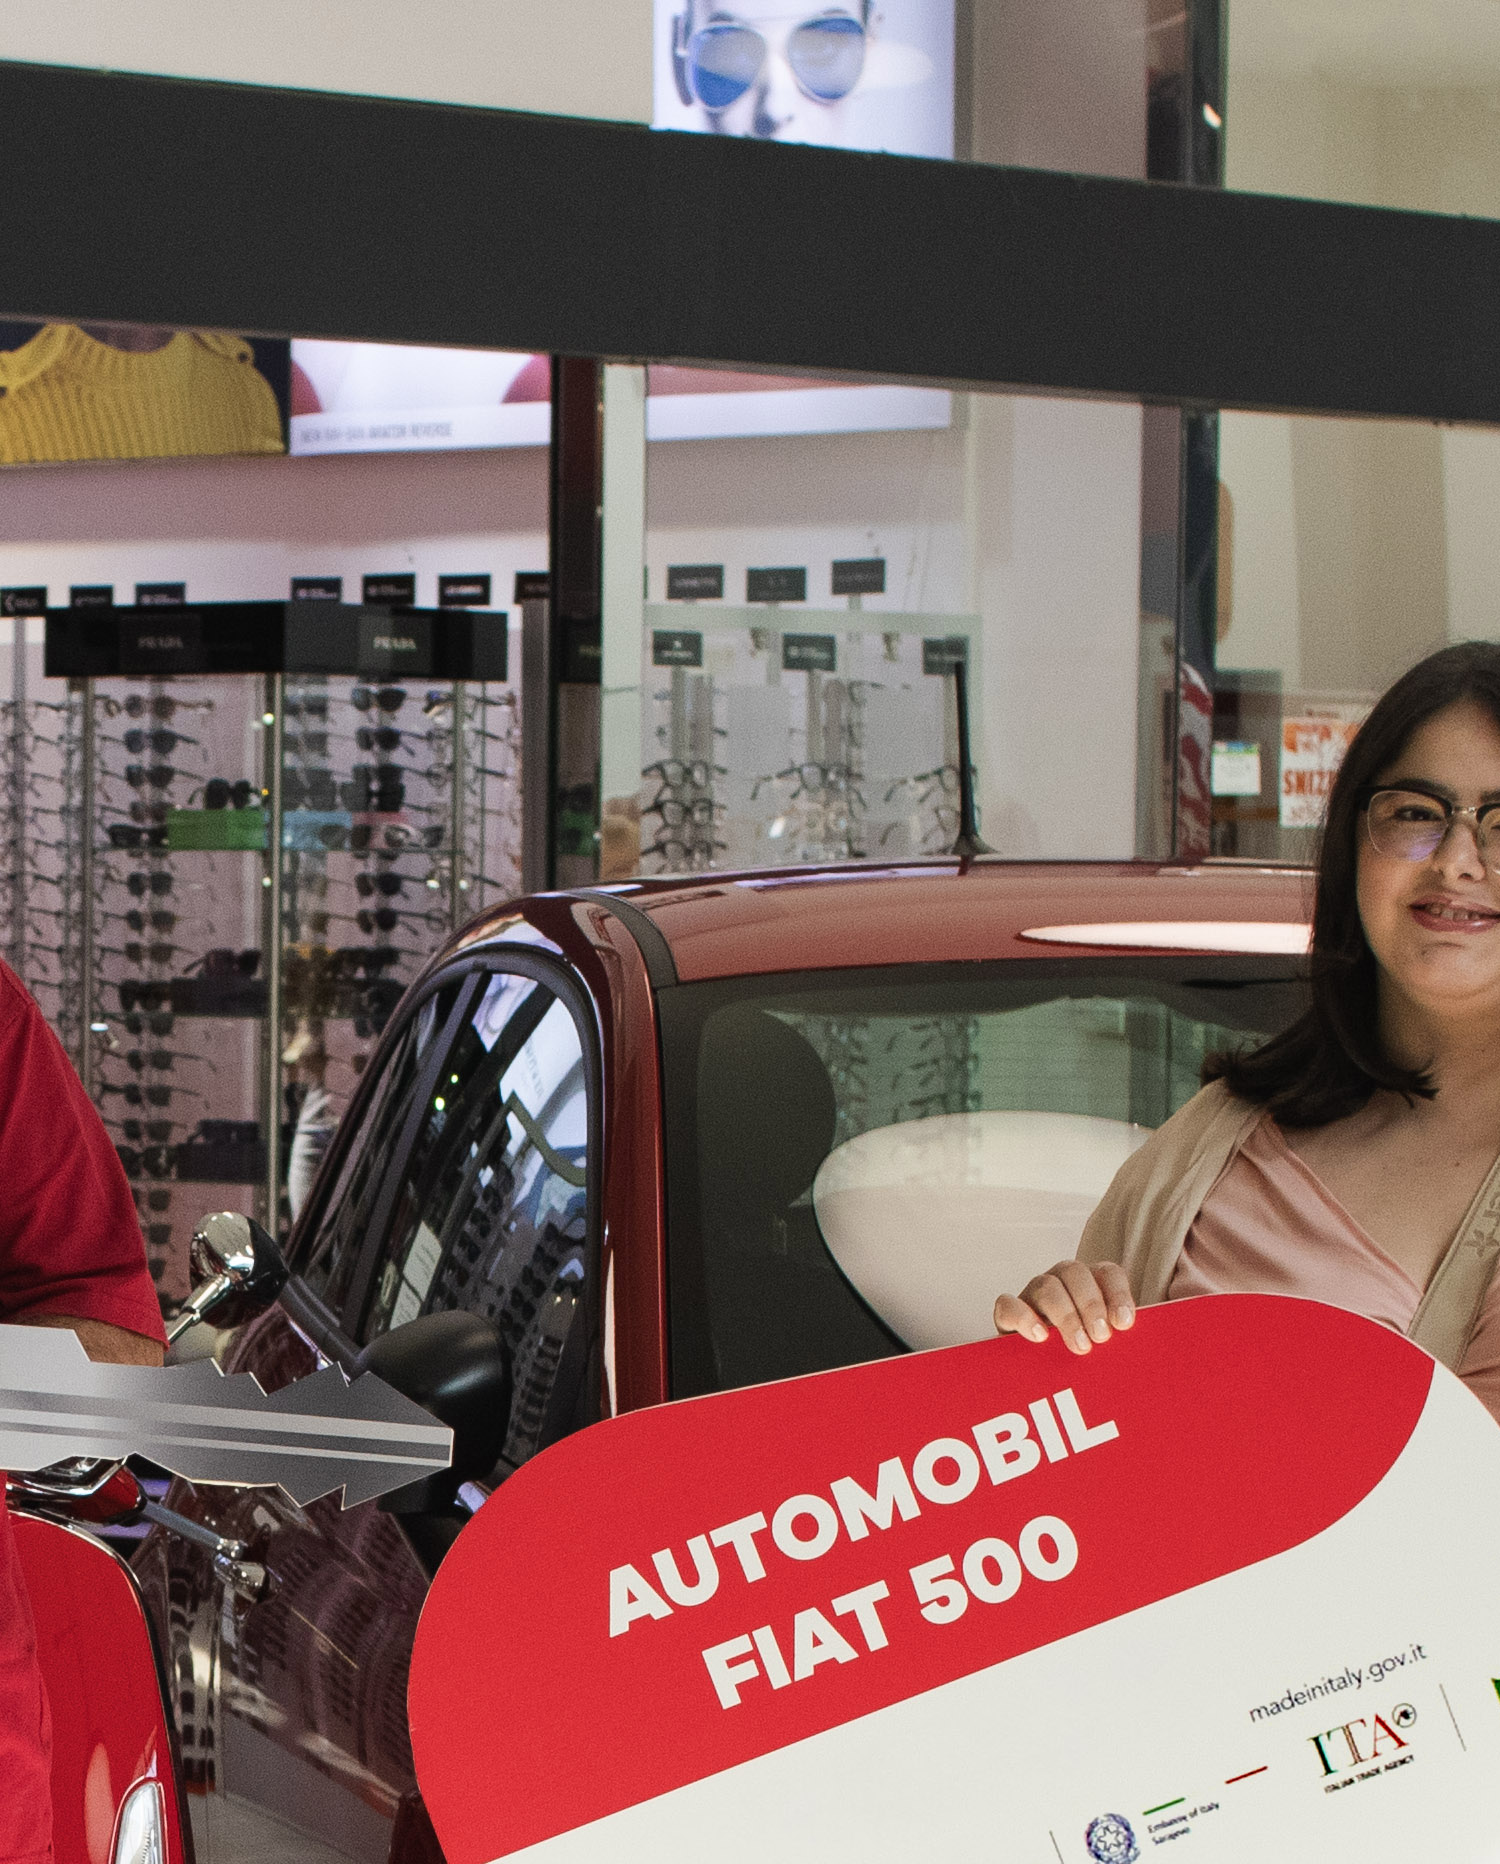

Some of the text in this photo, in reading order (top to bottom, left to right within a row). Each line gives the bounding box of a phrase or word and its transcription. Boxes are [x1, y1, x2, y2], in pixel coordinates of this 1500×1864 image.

[609, 1387, 1120, 1639] AUTOMOBIL
[701, 1514, 1080, 1711] FIAT 500
[1249, 1643, 1429, 1723] madeinitaly.gov.it
[1307, 1713, 1410, 1778] ITA
